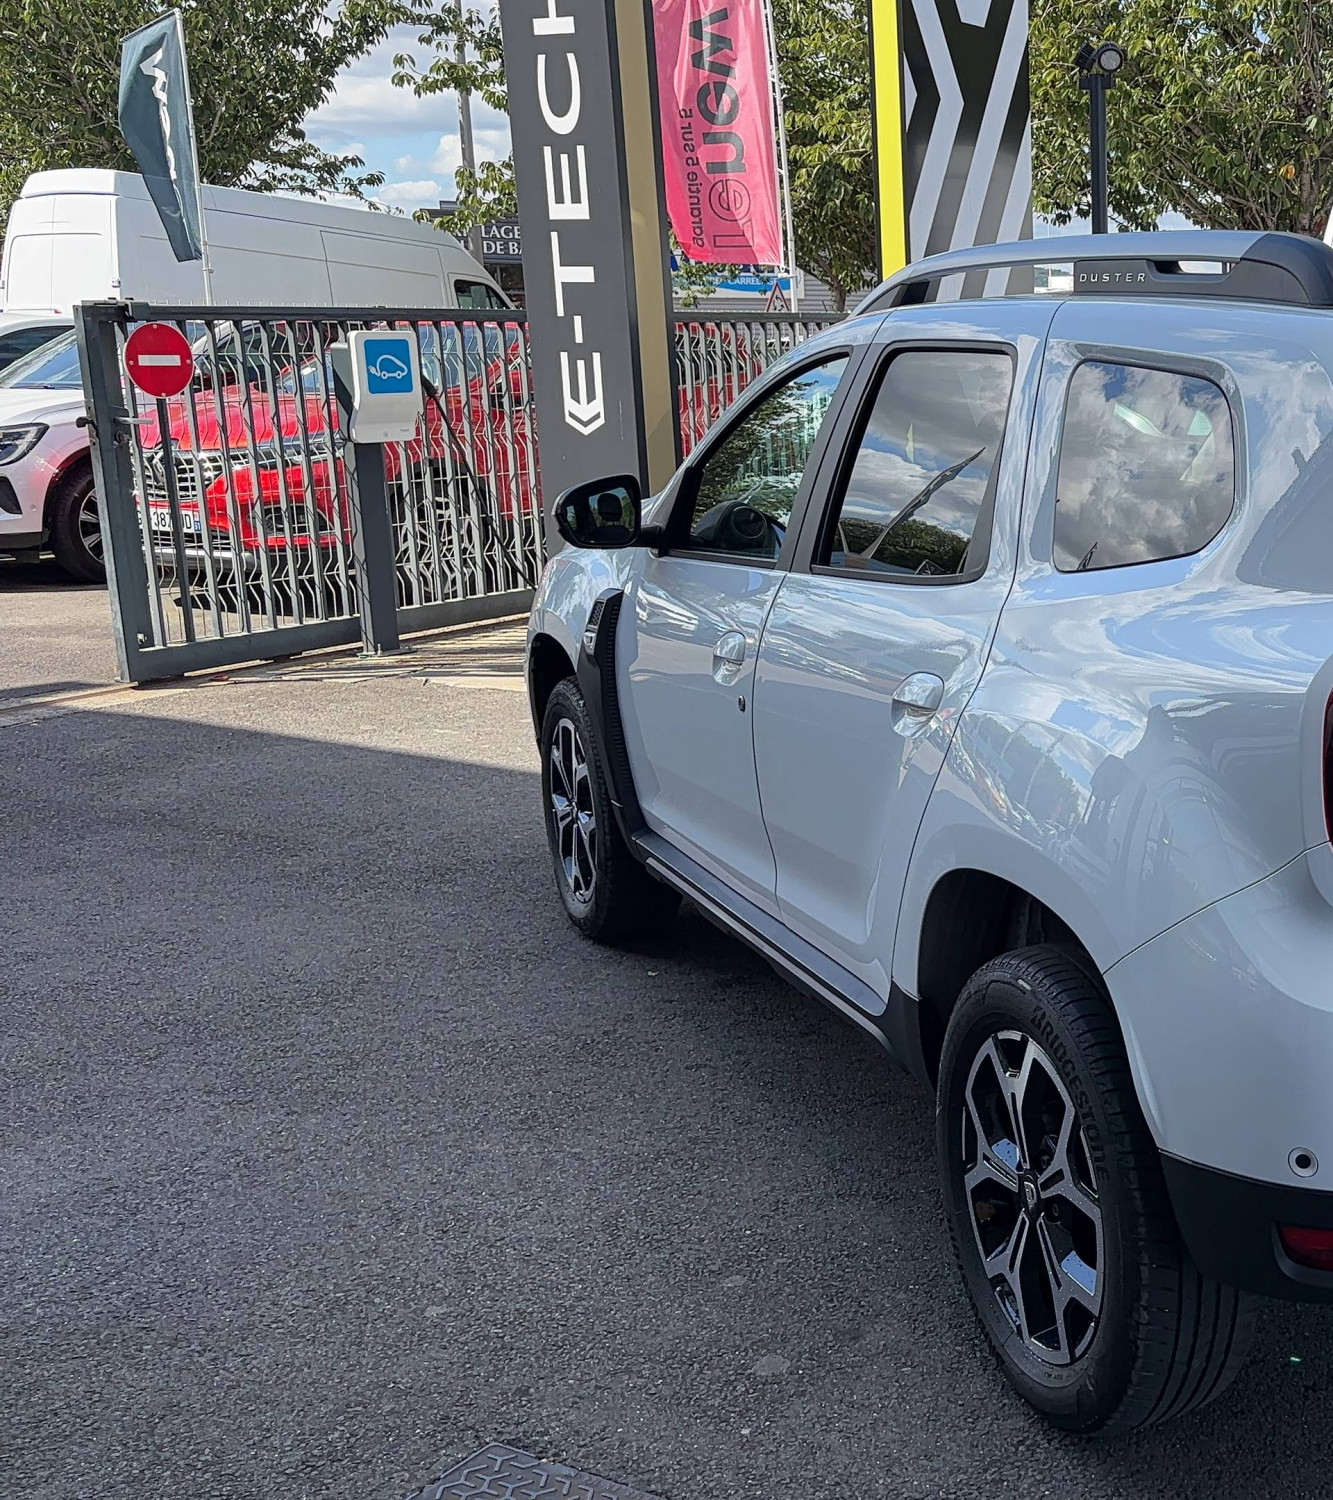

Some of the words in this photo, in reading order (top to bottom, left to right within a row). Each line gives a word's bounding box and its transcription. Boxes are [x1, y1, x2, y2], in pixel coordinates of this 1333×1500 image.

[482, 240, 504, 254] DE
[508, 241, 522, 255] B
[1079, 273, 1146, 282] DUSTER
[1030, 1004, 1110, 1182] BRIDGESTONE
